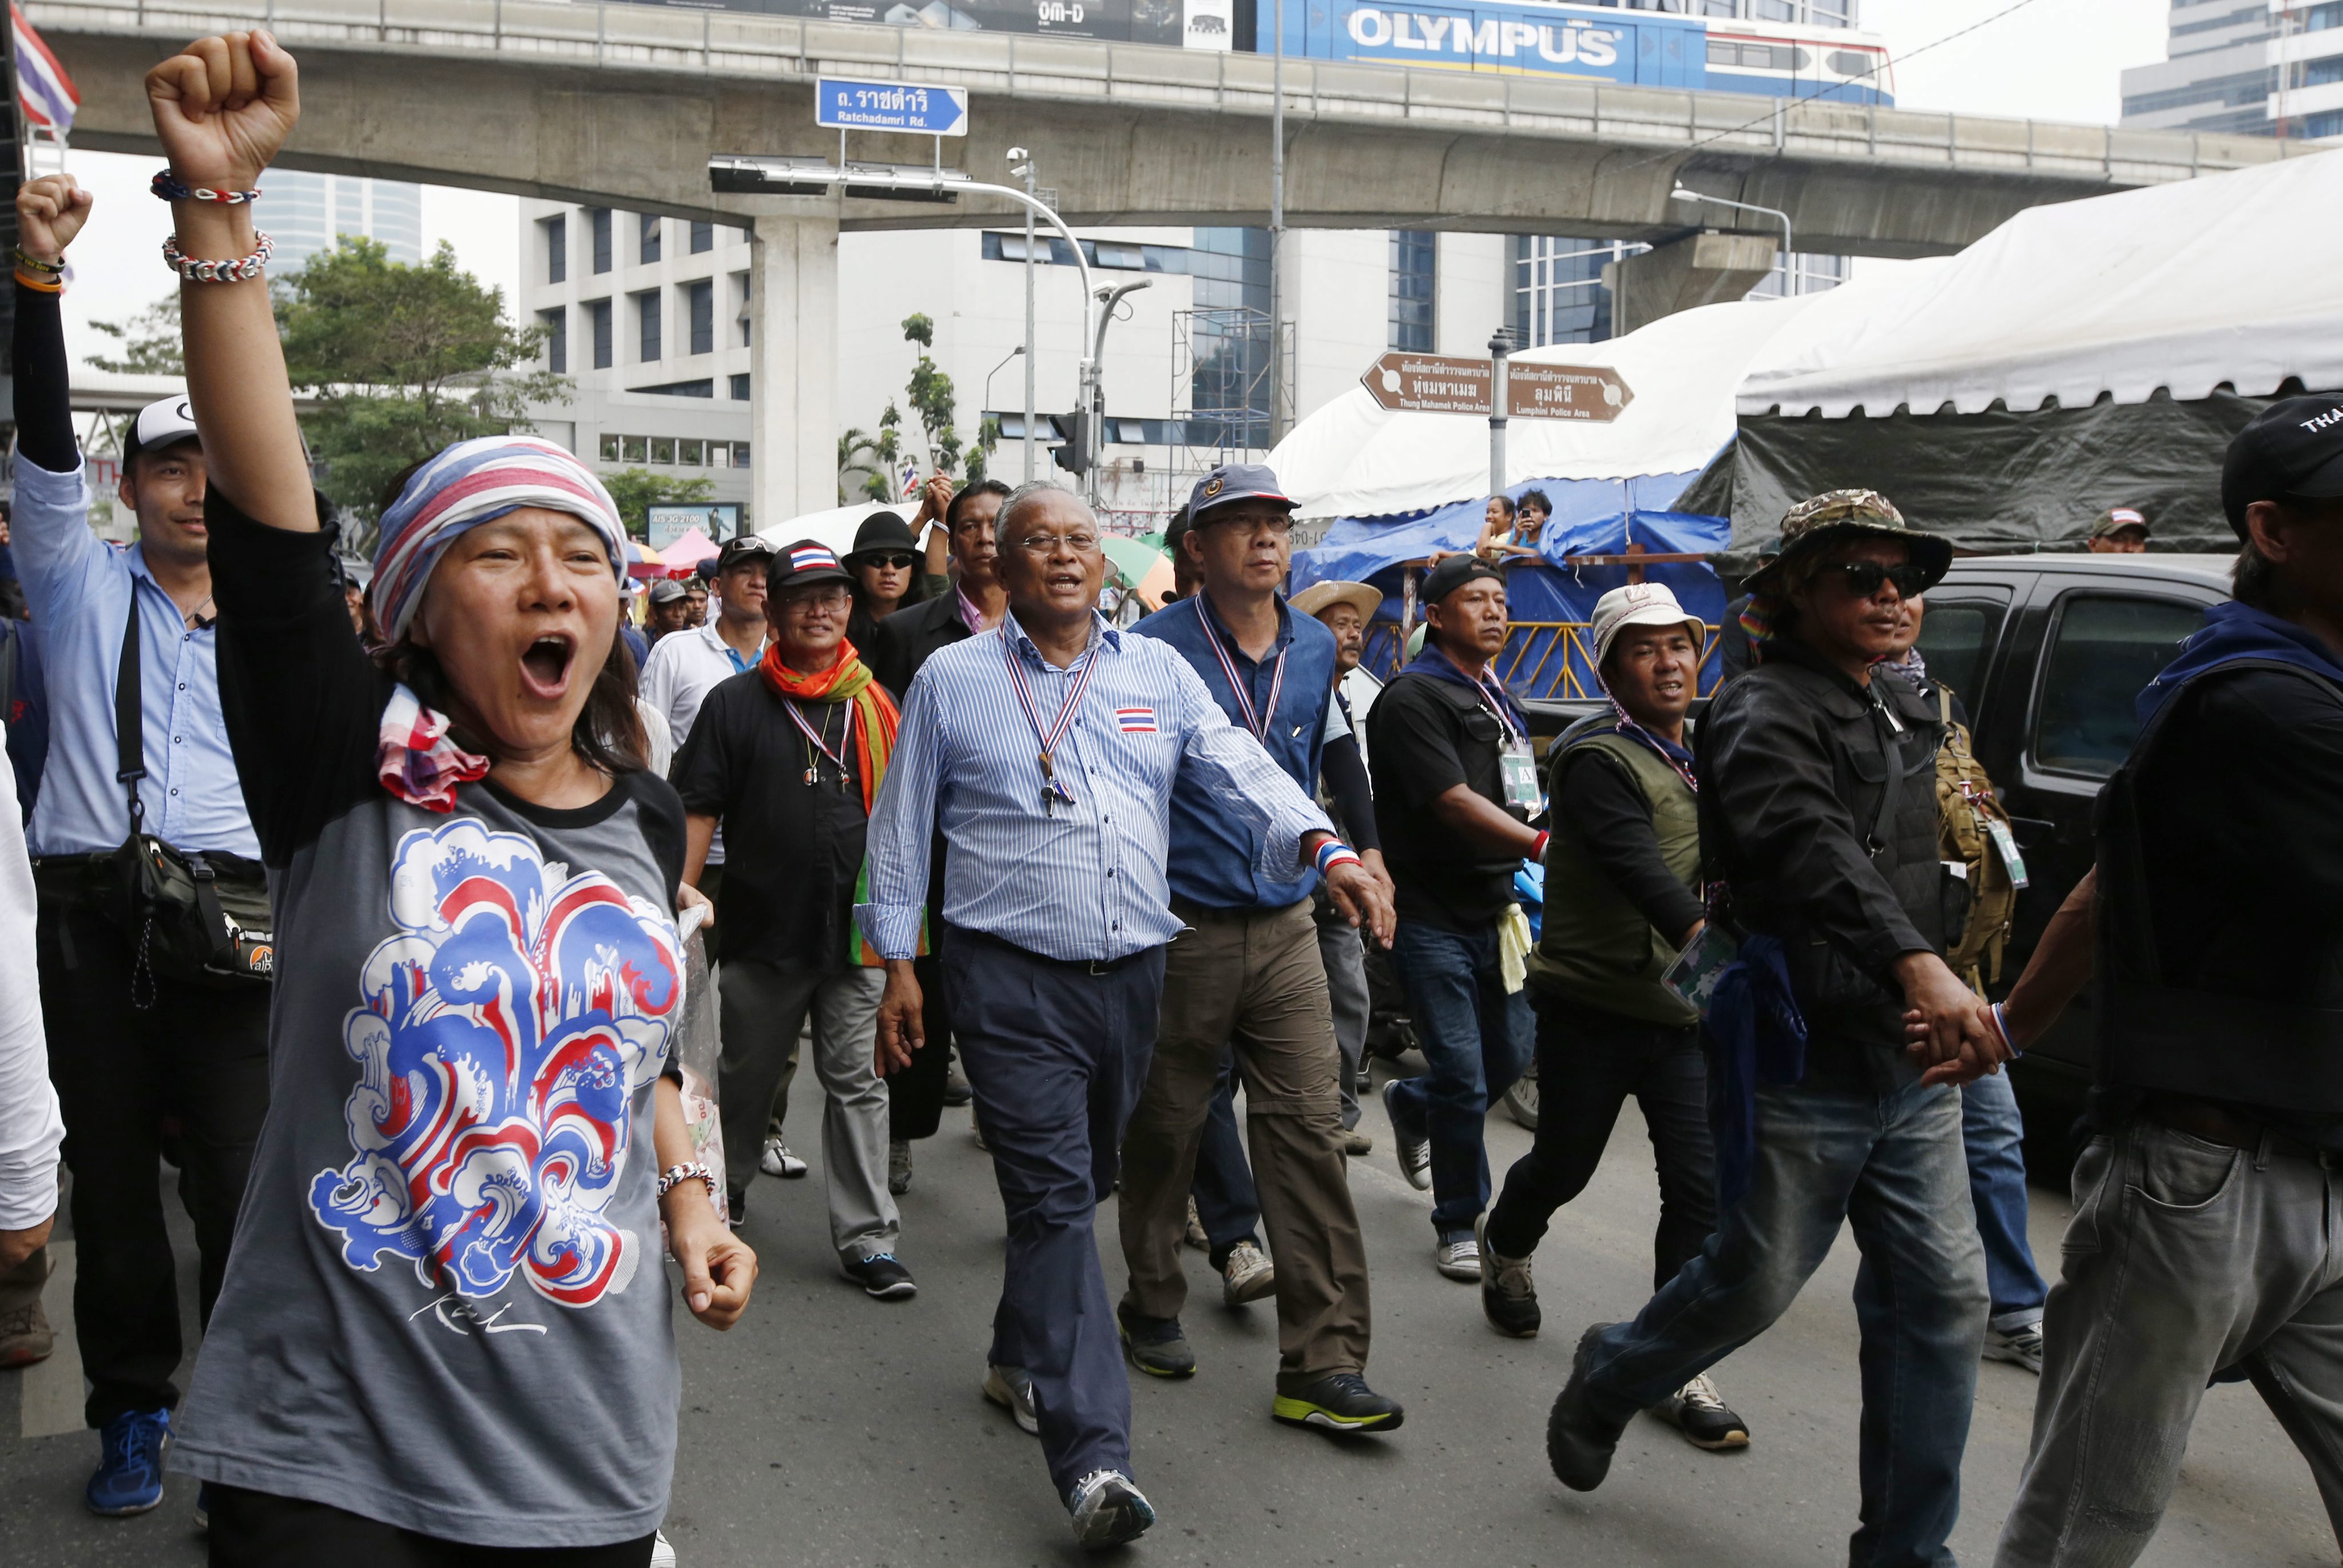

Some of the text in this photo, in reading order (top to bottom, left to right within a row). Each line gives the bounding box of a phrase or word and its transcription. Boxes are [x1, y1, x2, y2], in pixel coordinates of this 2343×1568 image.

[1038, 1, 1084, 23] OM-D
[1347, 9, 1618, 67] OLYMPUS
[837, 87, 928, 113] ถ. ราชดำริ
[837, 110, 927, 127] Ratchadamri Rd.
[1400, 398, 1490, 412] Thung Mahamek Police Area
[1535, 384, 1572, 407] ลุมพินี
[1516, 403, 1590, 418] Lumphini Police Area
[652, 515, 701, 523] AIS 3G 2100
